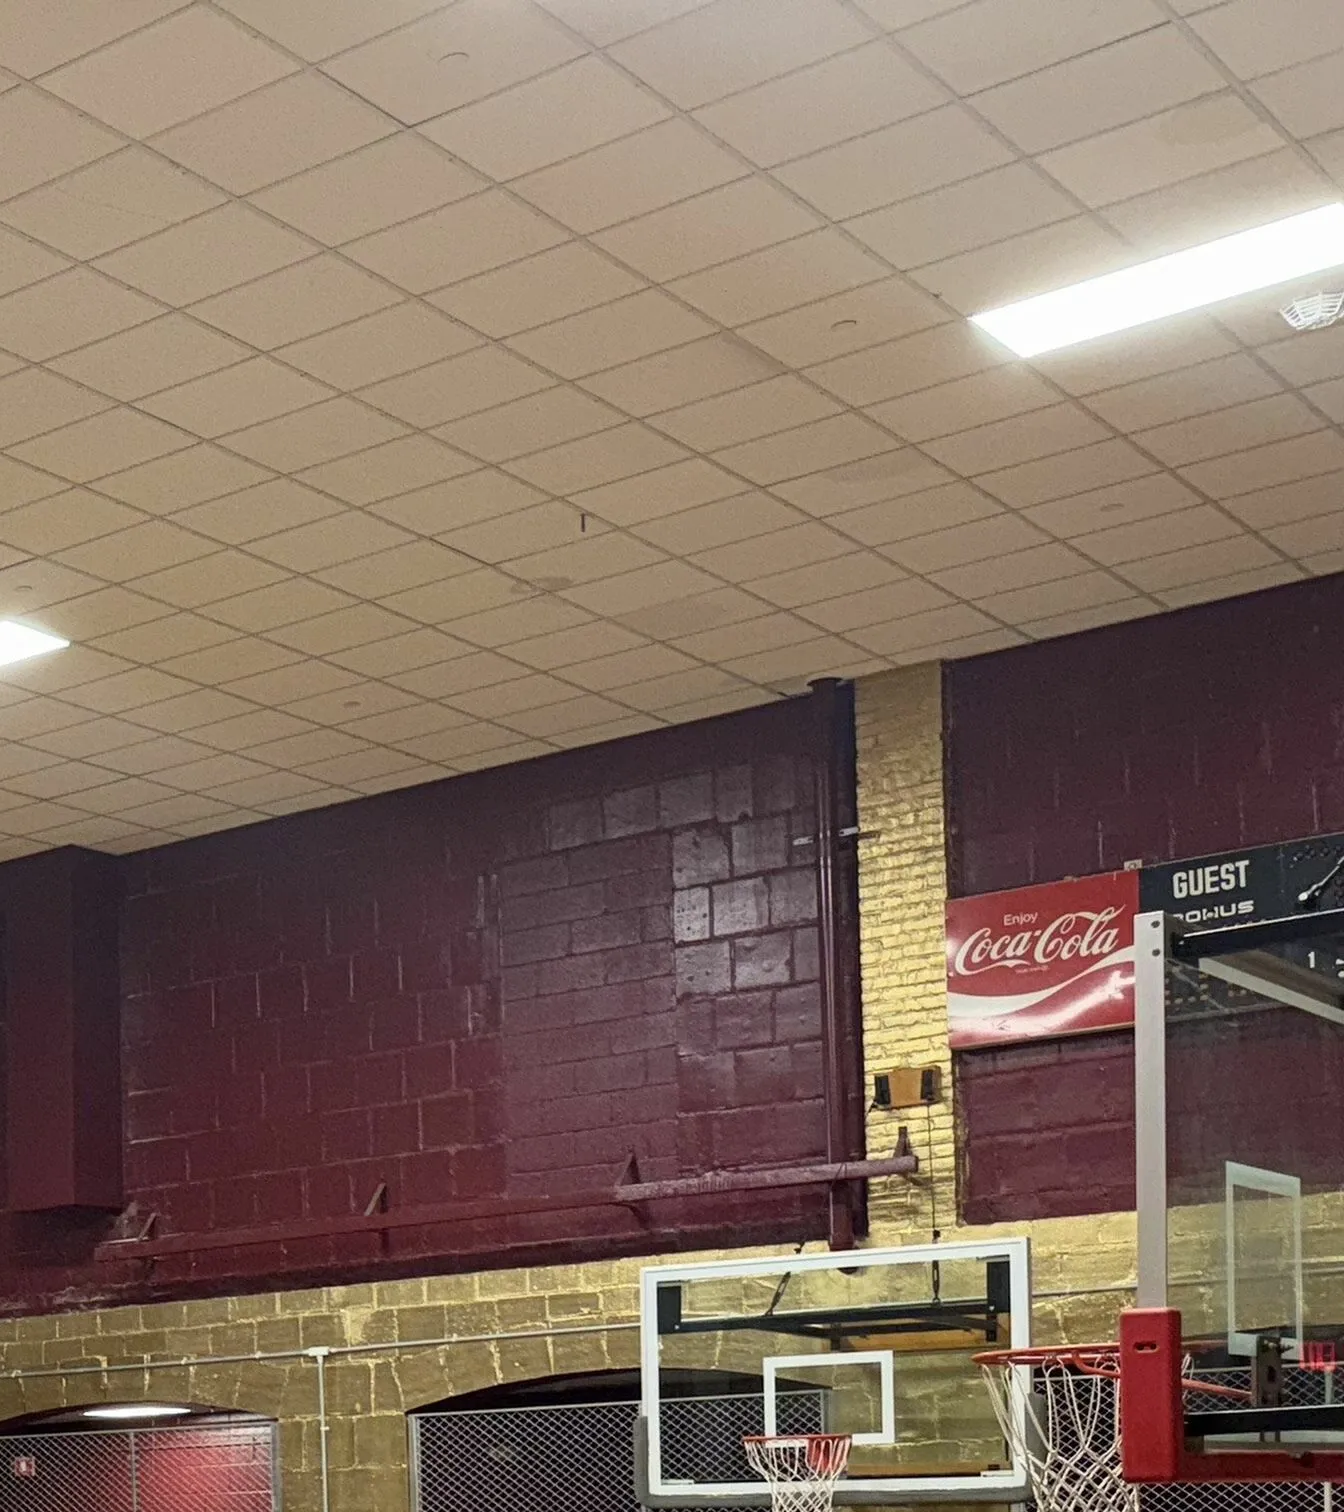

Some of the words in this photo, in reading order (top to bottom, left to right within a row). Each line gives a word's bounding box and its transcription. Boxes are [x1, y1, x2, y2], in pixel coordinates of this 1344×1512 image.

[1172, 859, 1250, 899] GUEST
[1003, 911, 1038, 926] Enjoy
[955, 903, 1126, 976] Coca-Cola
